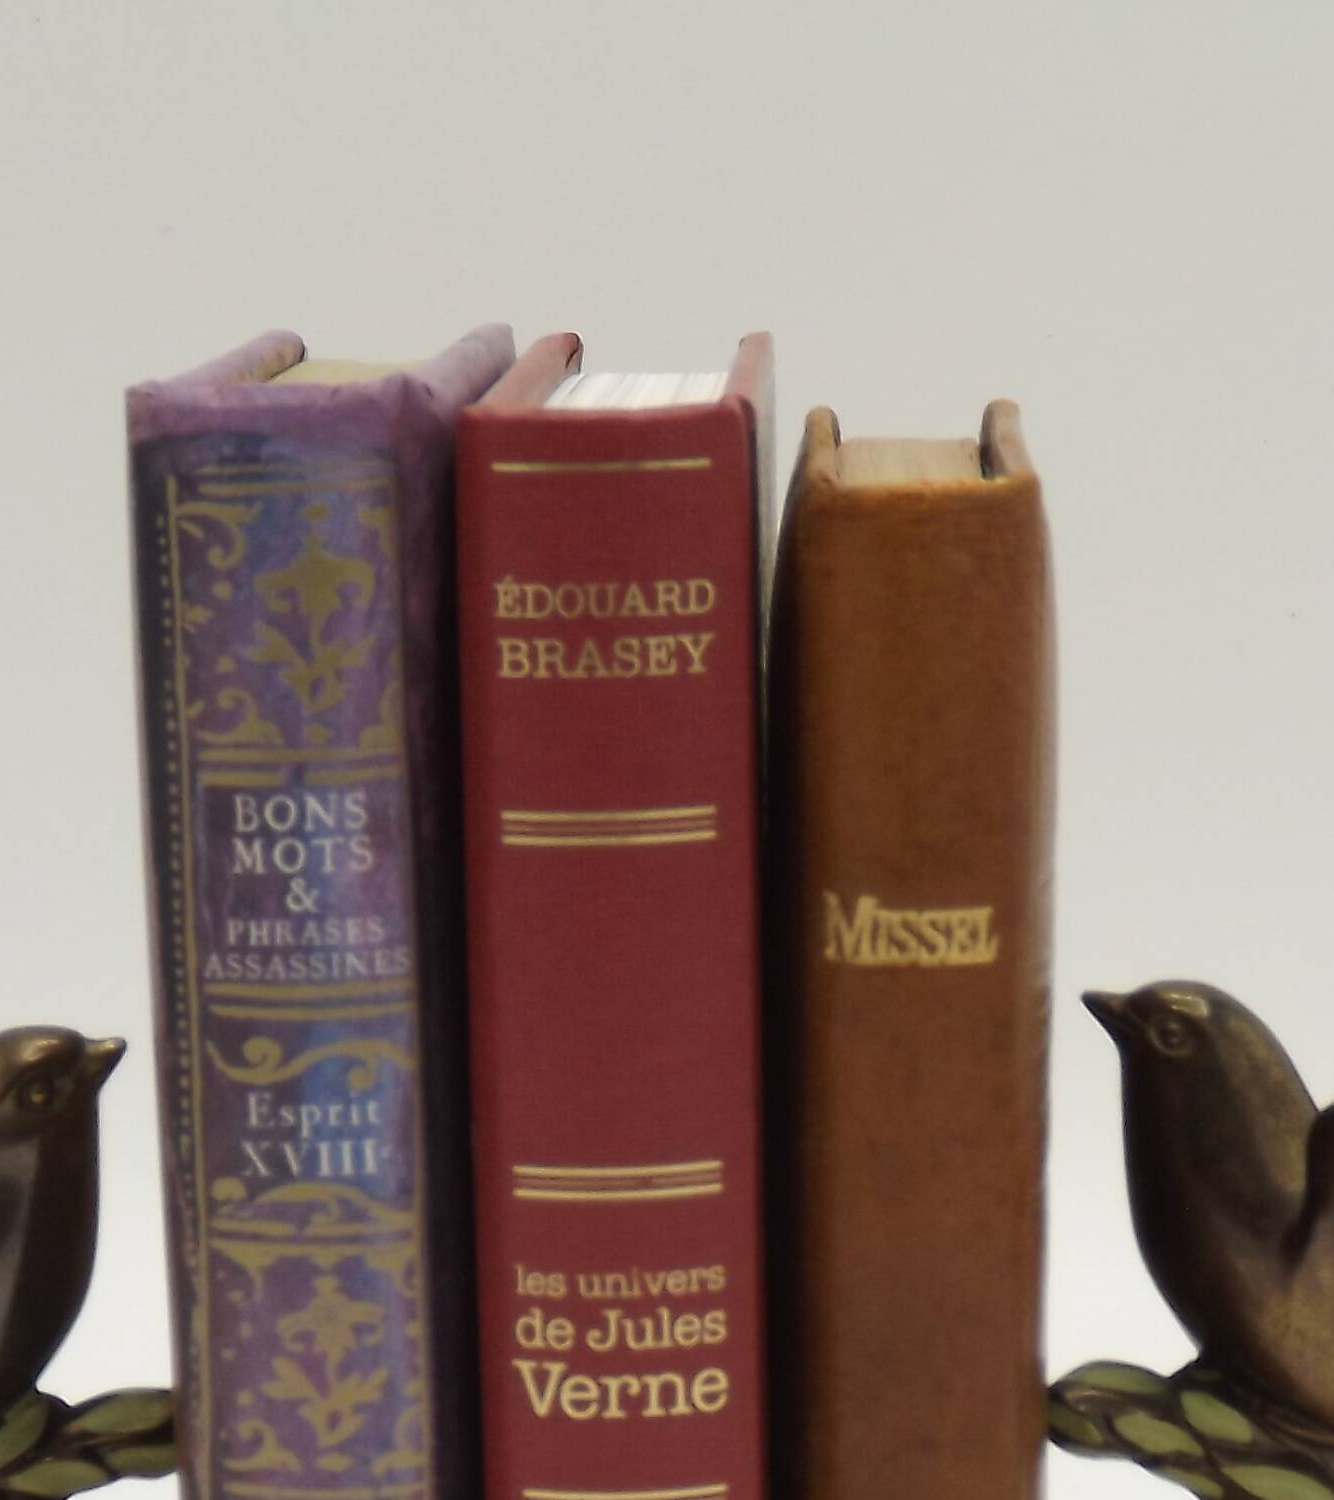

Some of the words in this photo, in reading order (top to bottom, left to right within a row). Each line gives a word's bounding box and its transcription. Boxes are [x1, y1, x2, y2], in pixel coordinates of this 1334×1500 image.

[493, 574, 714, 619] ÉDOUARD
[497, 632, 713, 678] BRASEY
[235, 792, 368, 832] BONS
[232, 835, 373, 875] MOTS
[285, 877, 320, 912] &
[227, 916, 385, 946] PHRASES
[204, 947, 411, 980] ASSASSINES
[247, 1090, 380, 1138] Esprit
[515, 1265, 566, 1298] les
[576, 1264, 725, 1298] univers
[515, 1307, 575, 1350] de
[585, 1306, 727, 1351] Jules
[511, 1358, 730, 1420] Verne
